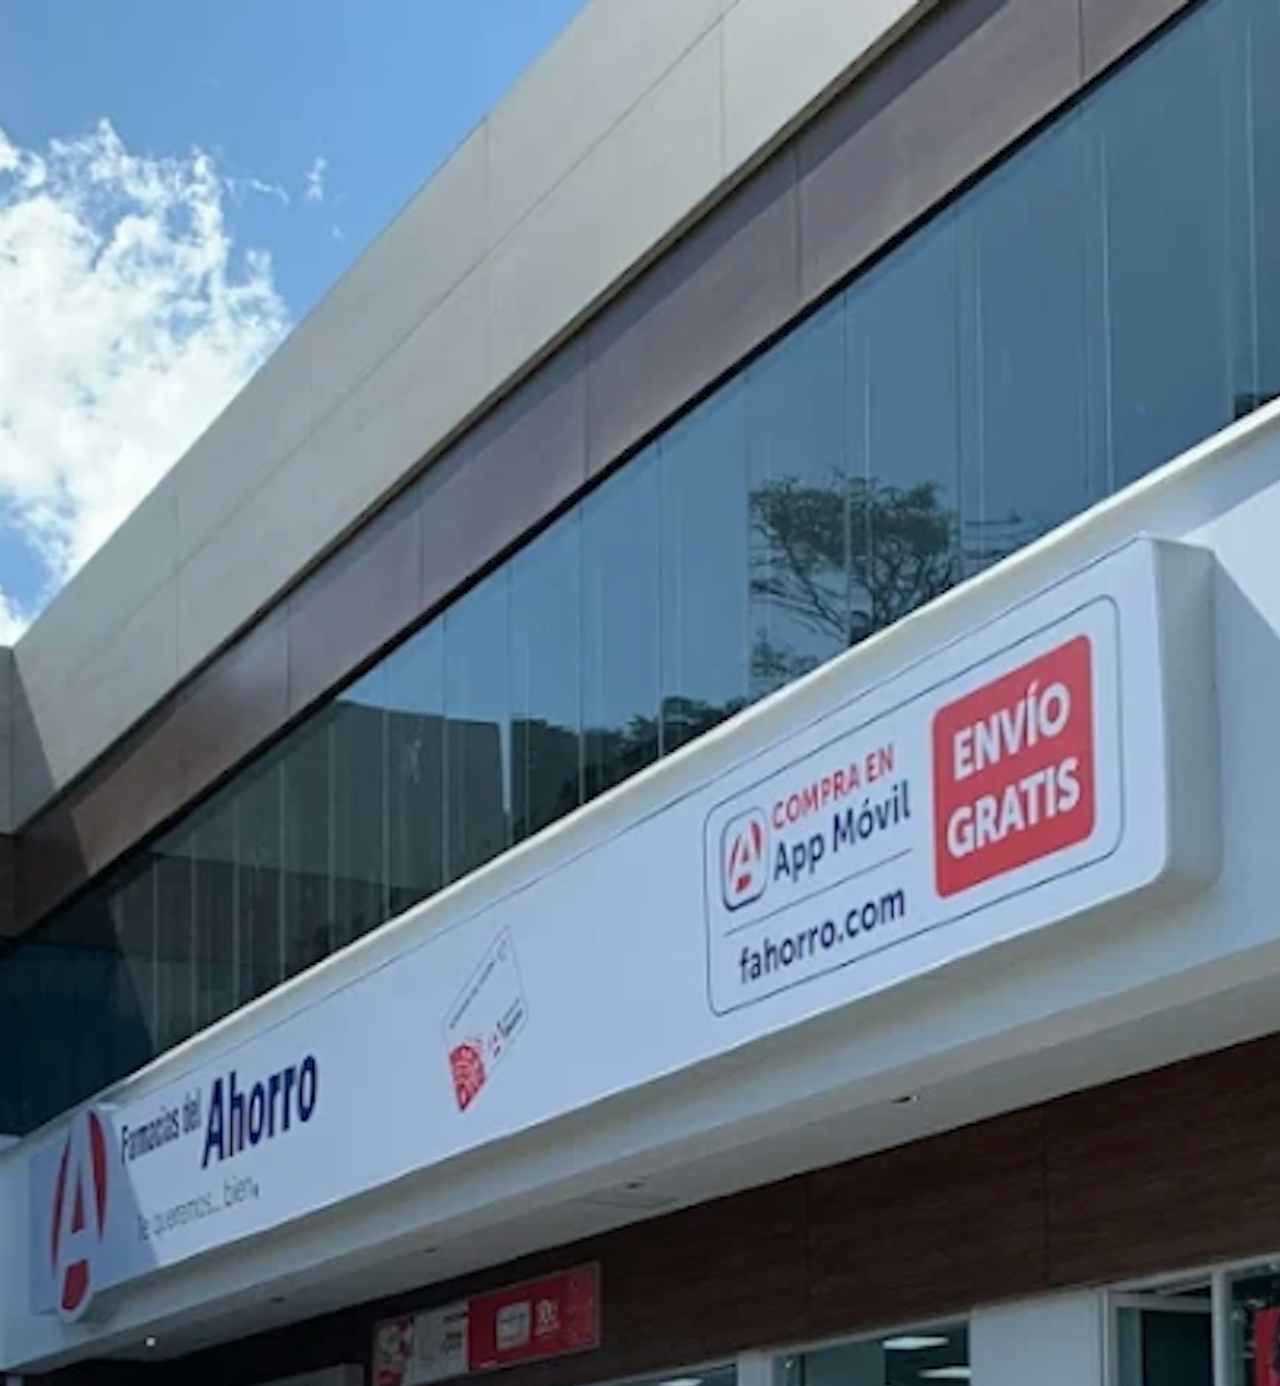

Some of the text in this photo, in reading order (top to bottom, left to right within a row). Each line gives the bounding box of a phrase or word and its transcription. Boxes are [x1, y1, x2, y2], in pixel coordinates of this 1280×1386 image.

[953, 682, 1071, 781] ENVÍO
[772, 743, 896, 830] COMPRA EN
[773, 779, 911, 882] App Móvil
[947, 757, 1080, 859] GRATIS
[738, 888, 905, 984] fahorro.com
[201, 1053, 318, 1171] Ahorro
